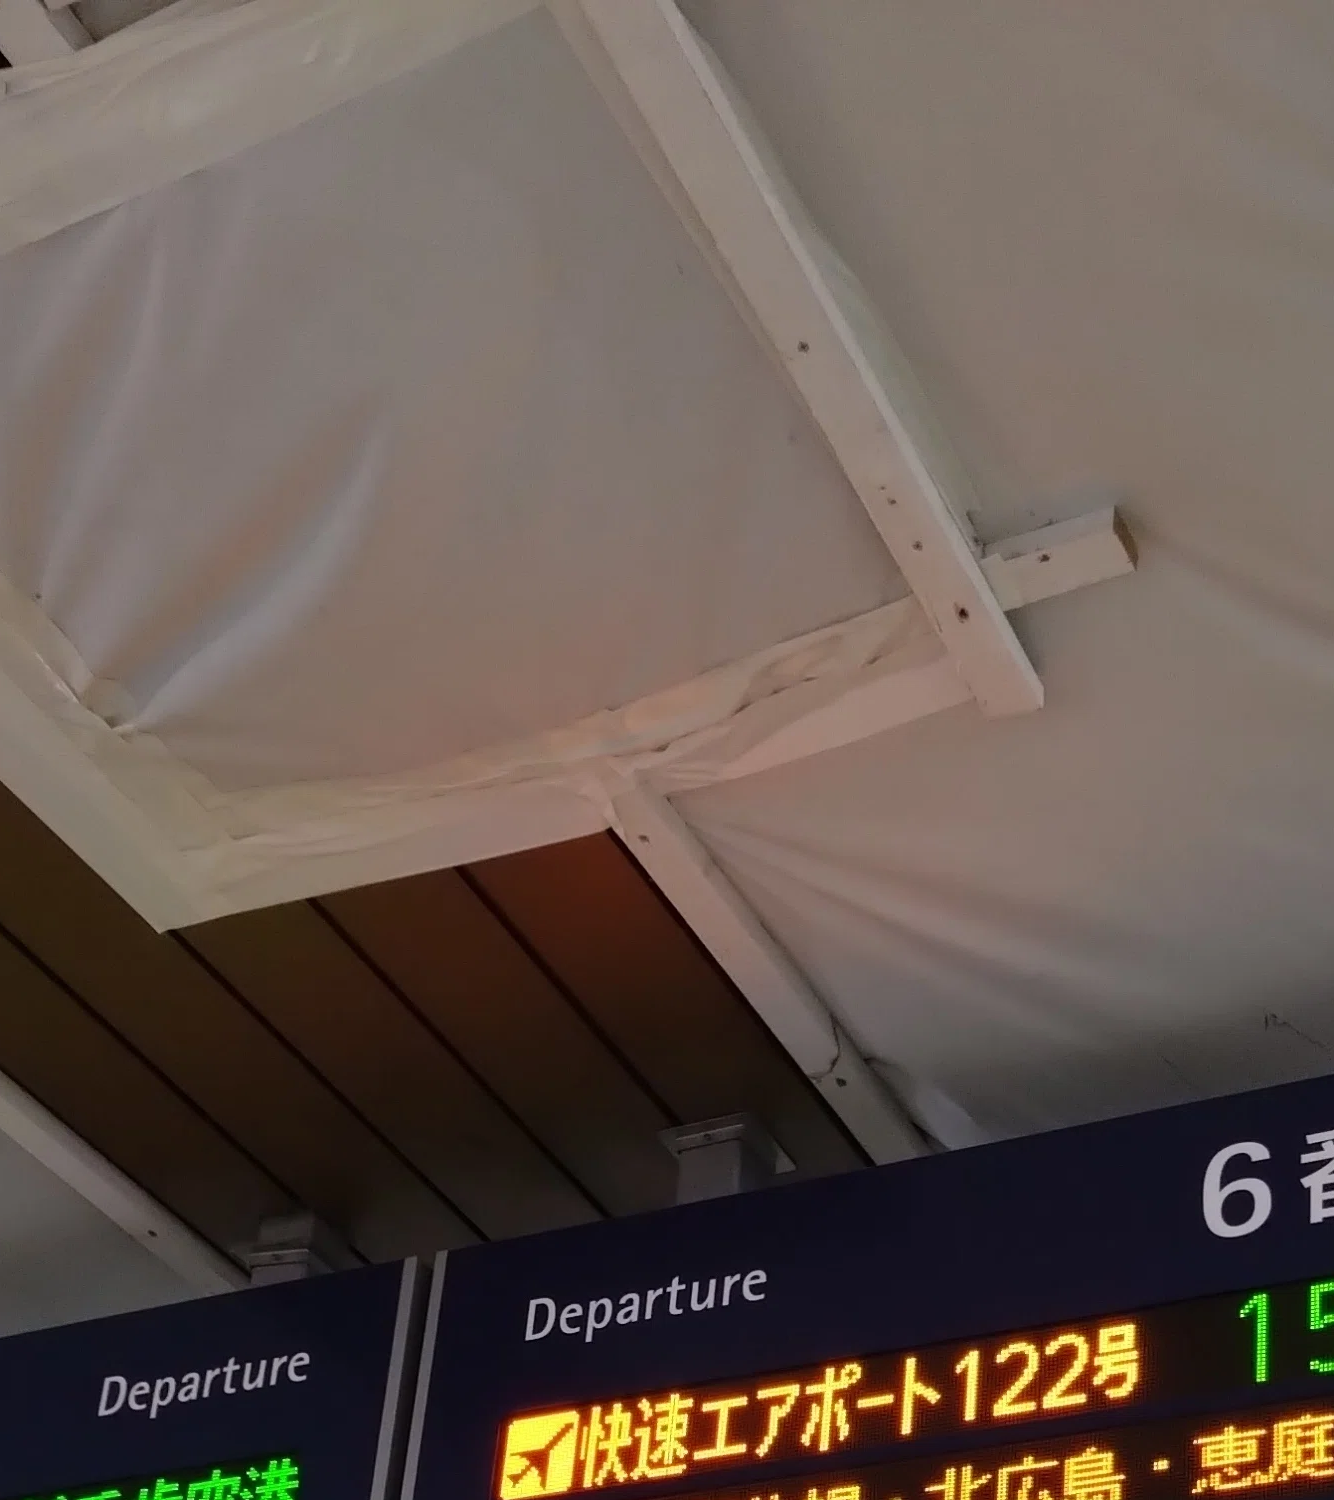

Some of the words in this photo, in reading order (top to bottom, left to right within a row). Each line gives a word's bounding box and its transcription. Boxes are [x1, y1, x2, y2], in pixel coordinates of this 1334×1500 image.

[525, 1270, 767, 1343] Departure
[98, 1352, 310, 1419] Departure
[571, 1322, 1139, 1490] 快速エアポート122号
